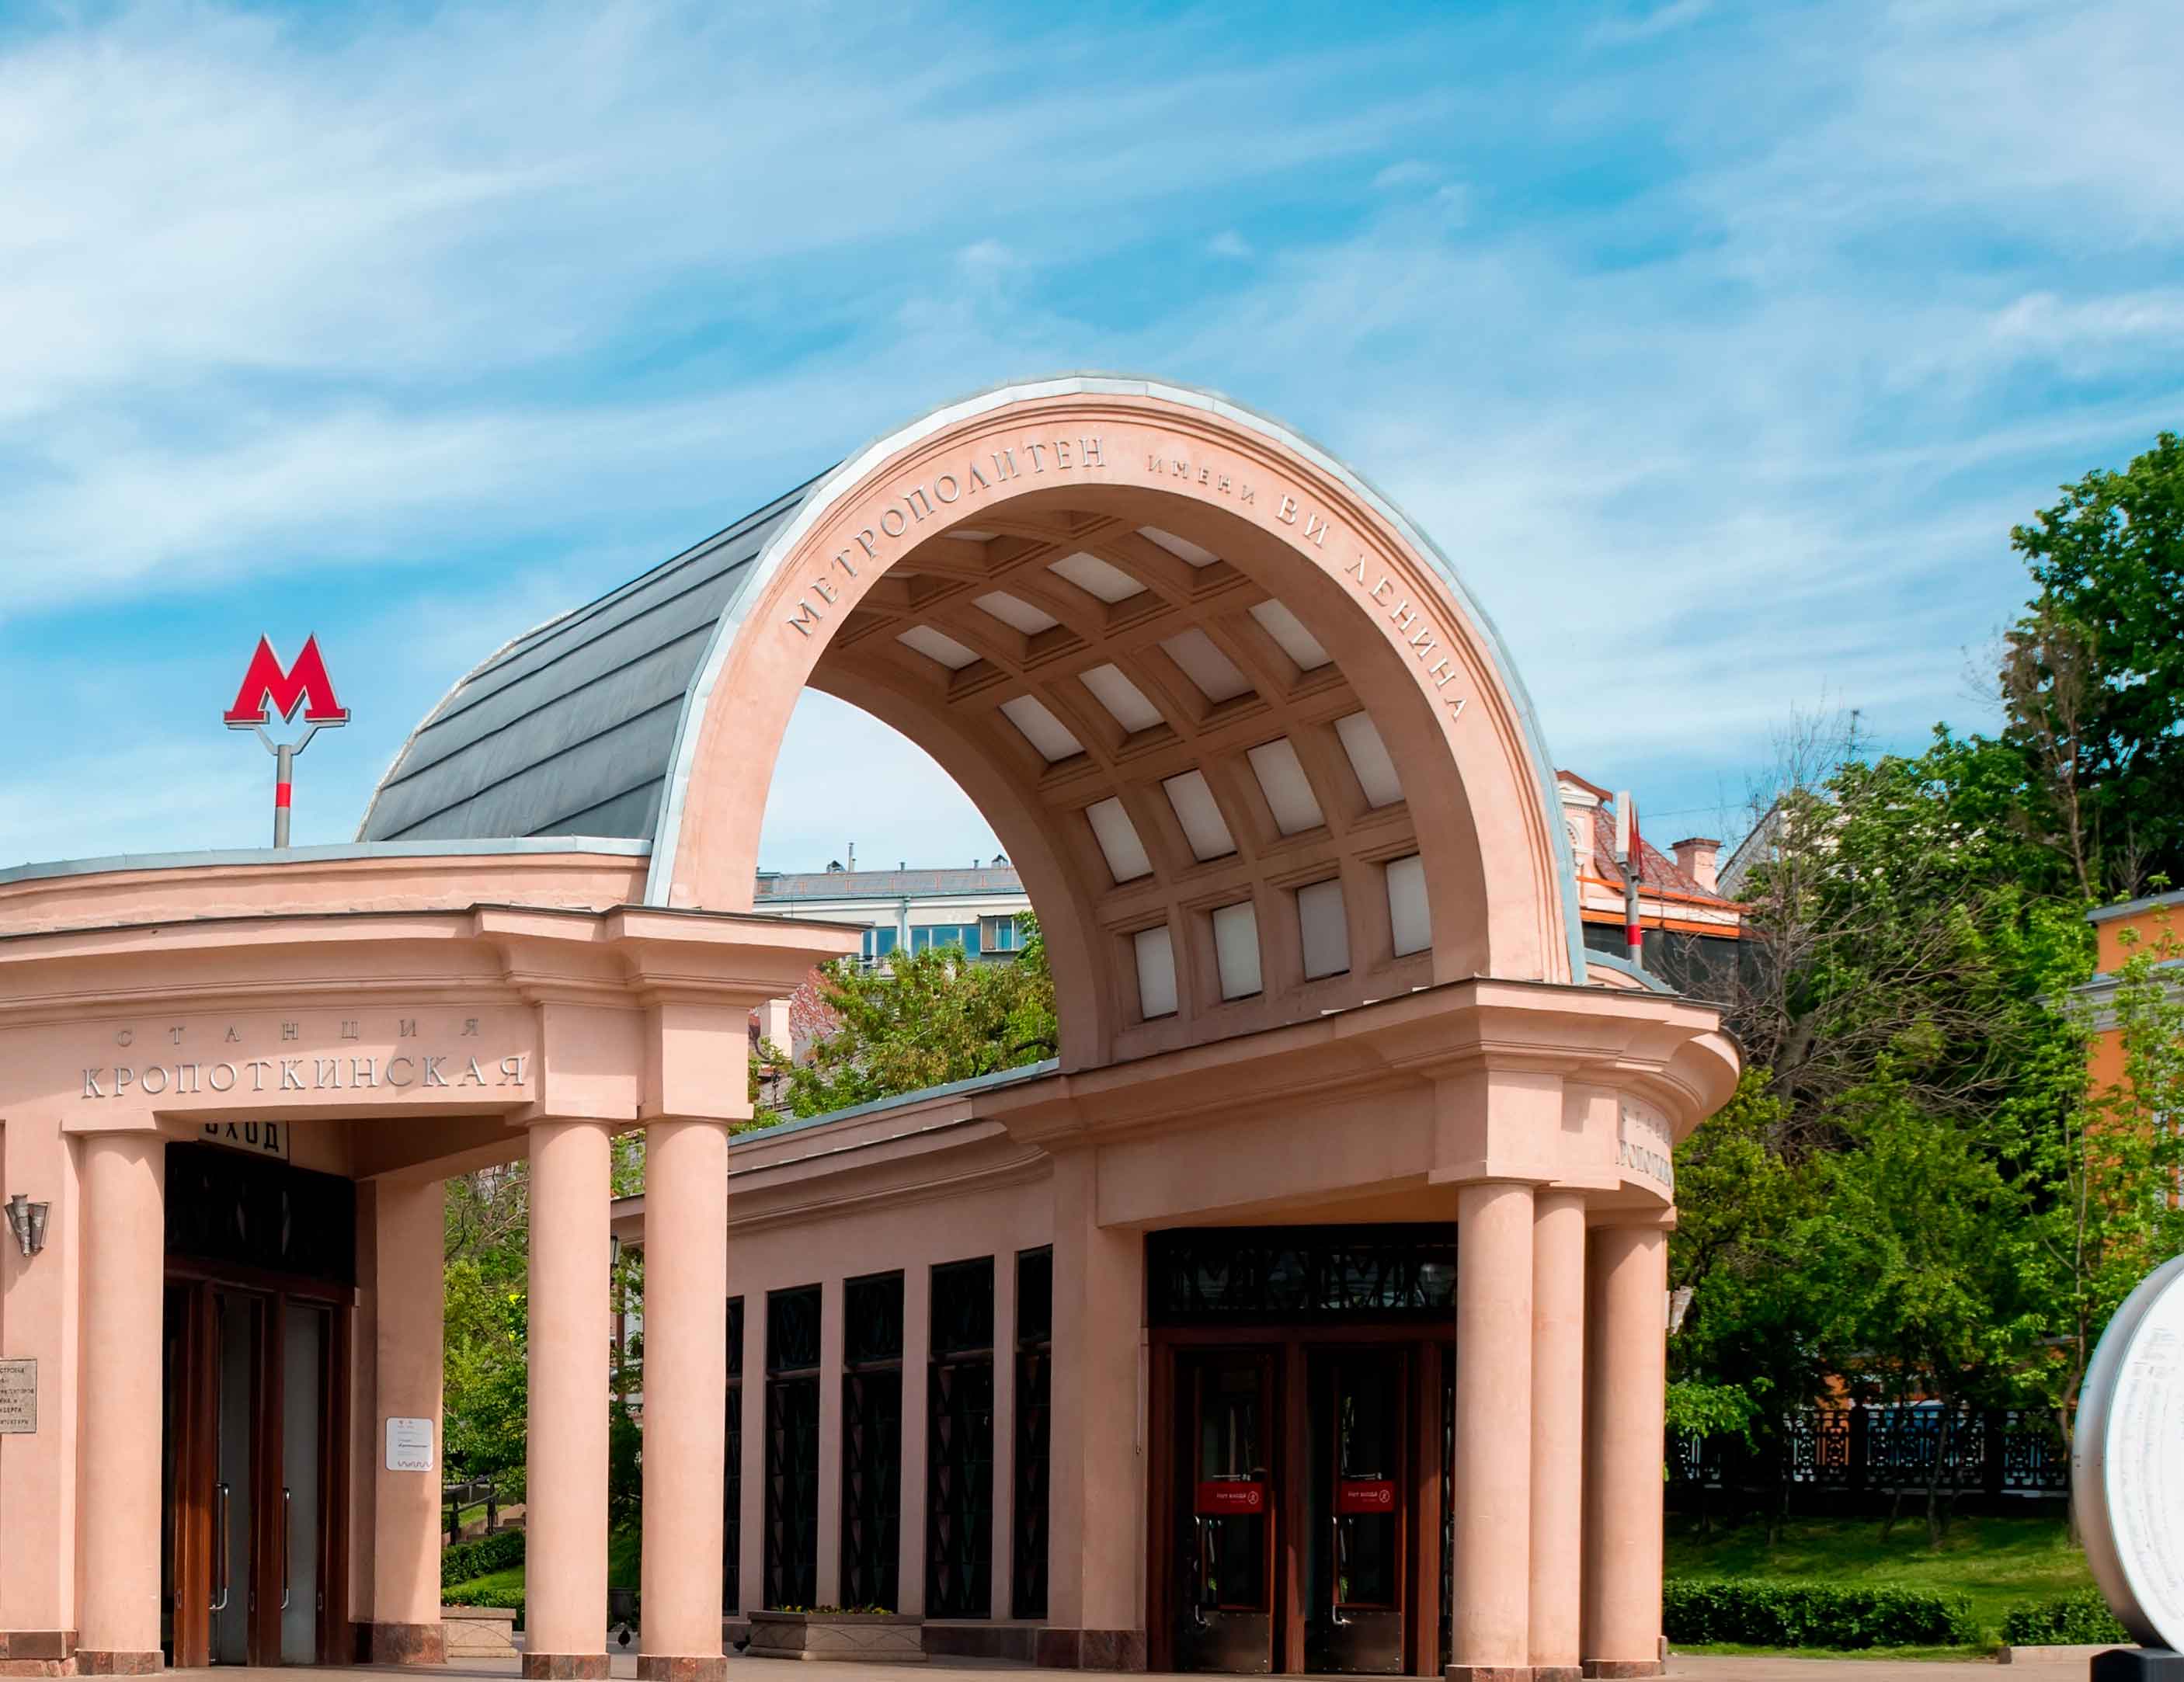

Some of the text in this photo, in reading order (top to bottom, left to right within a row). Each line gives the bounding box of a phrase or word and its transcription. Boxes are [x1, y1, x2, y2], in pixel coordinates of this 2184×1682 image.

[787, 436, 1107, 638] МЕТРОПОЛИТЕН
[1147, 454, 1256, 506] ИМЕНИ
[1344, 553, 1469, 723] ЛЕНИНА
[117, 1018, 480, 1048] СТАНЦИЯ
[81, 1054, 527, 1100] КРОПОТКИНСКАЯ
